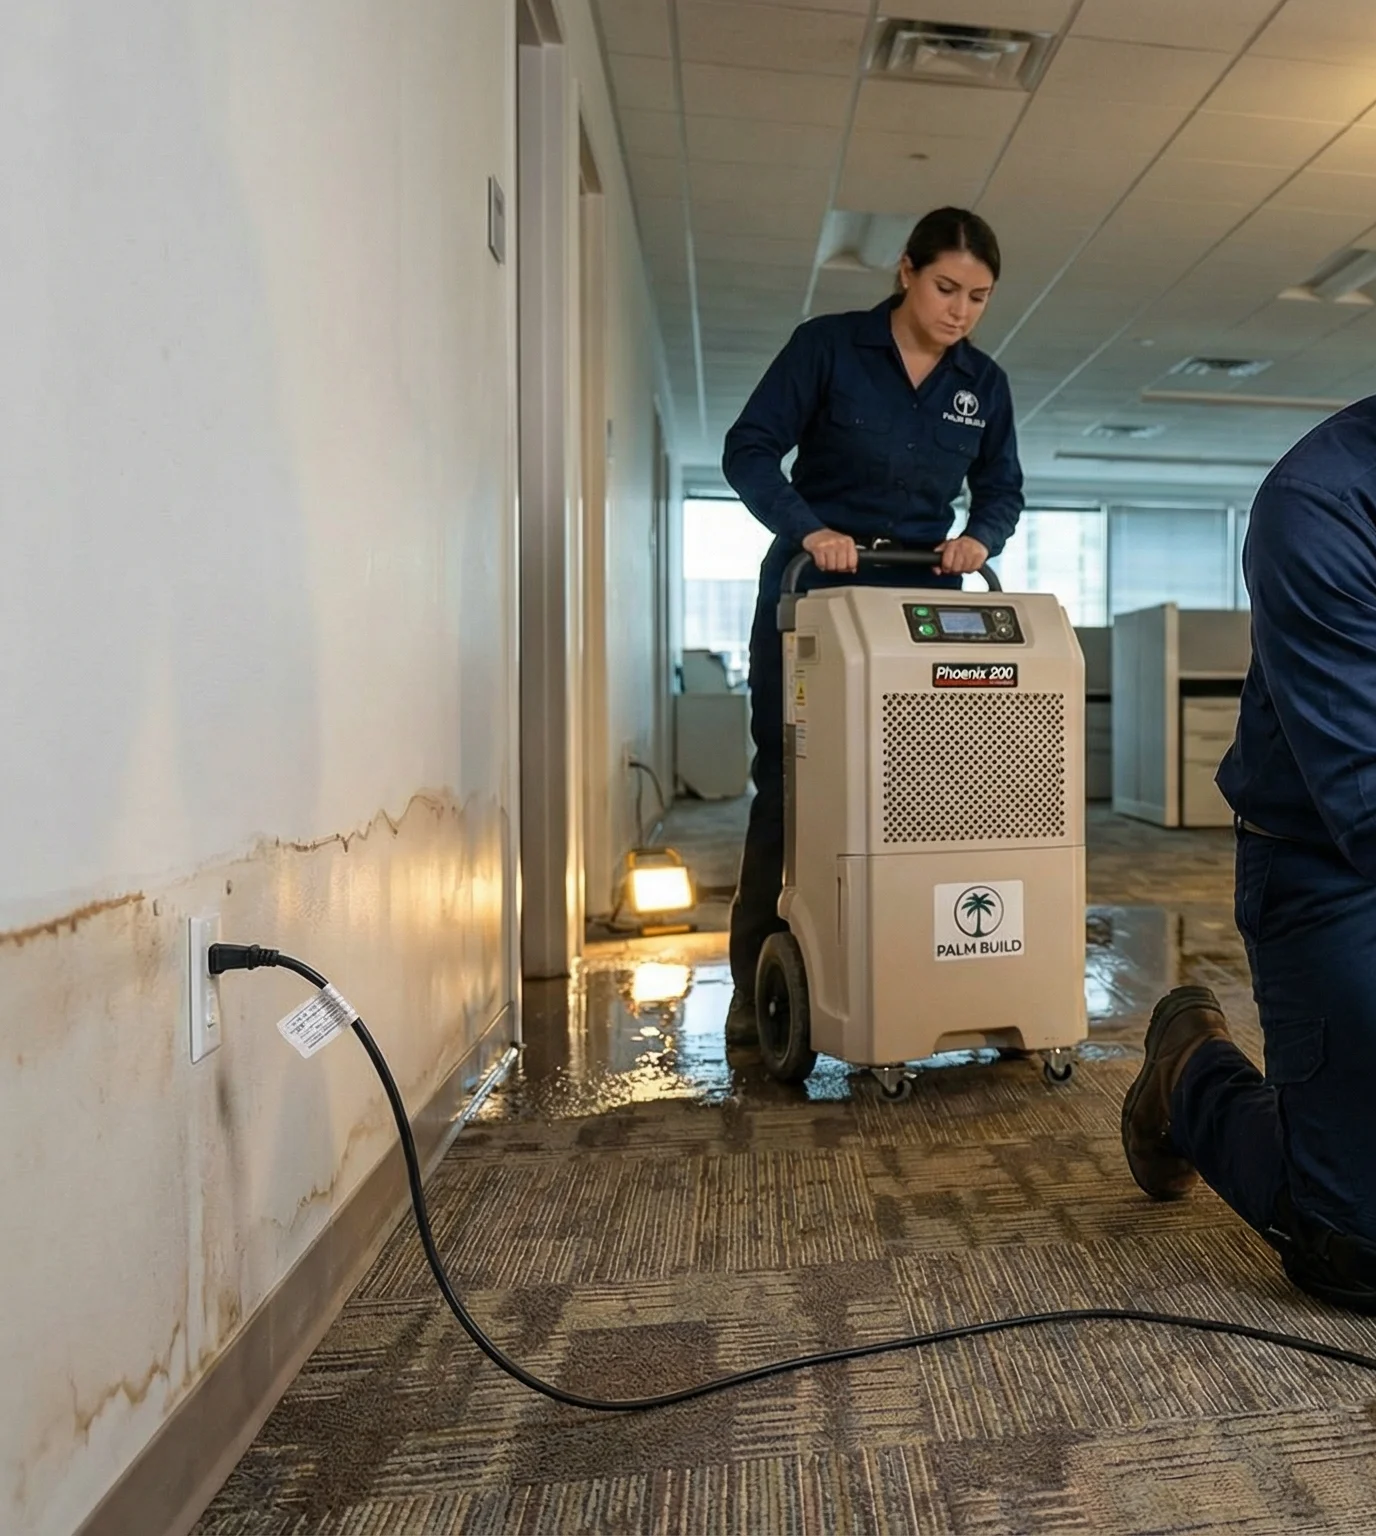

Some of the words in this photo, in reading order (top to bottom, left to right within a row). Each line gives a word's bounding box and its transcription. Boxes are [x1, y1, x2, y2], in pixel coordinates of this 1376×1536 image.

[936, 666, 987, 680] Phoenix
[989, 666, 1014, 680] 200
[937, 942, 977, 957] PALM
[980, 939, 1023, 954] BUILD
